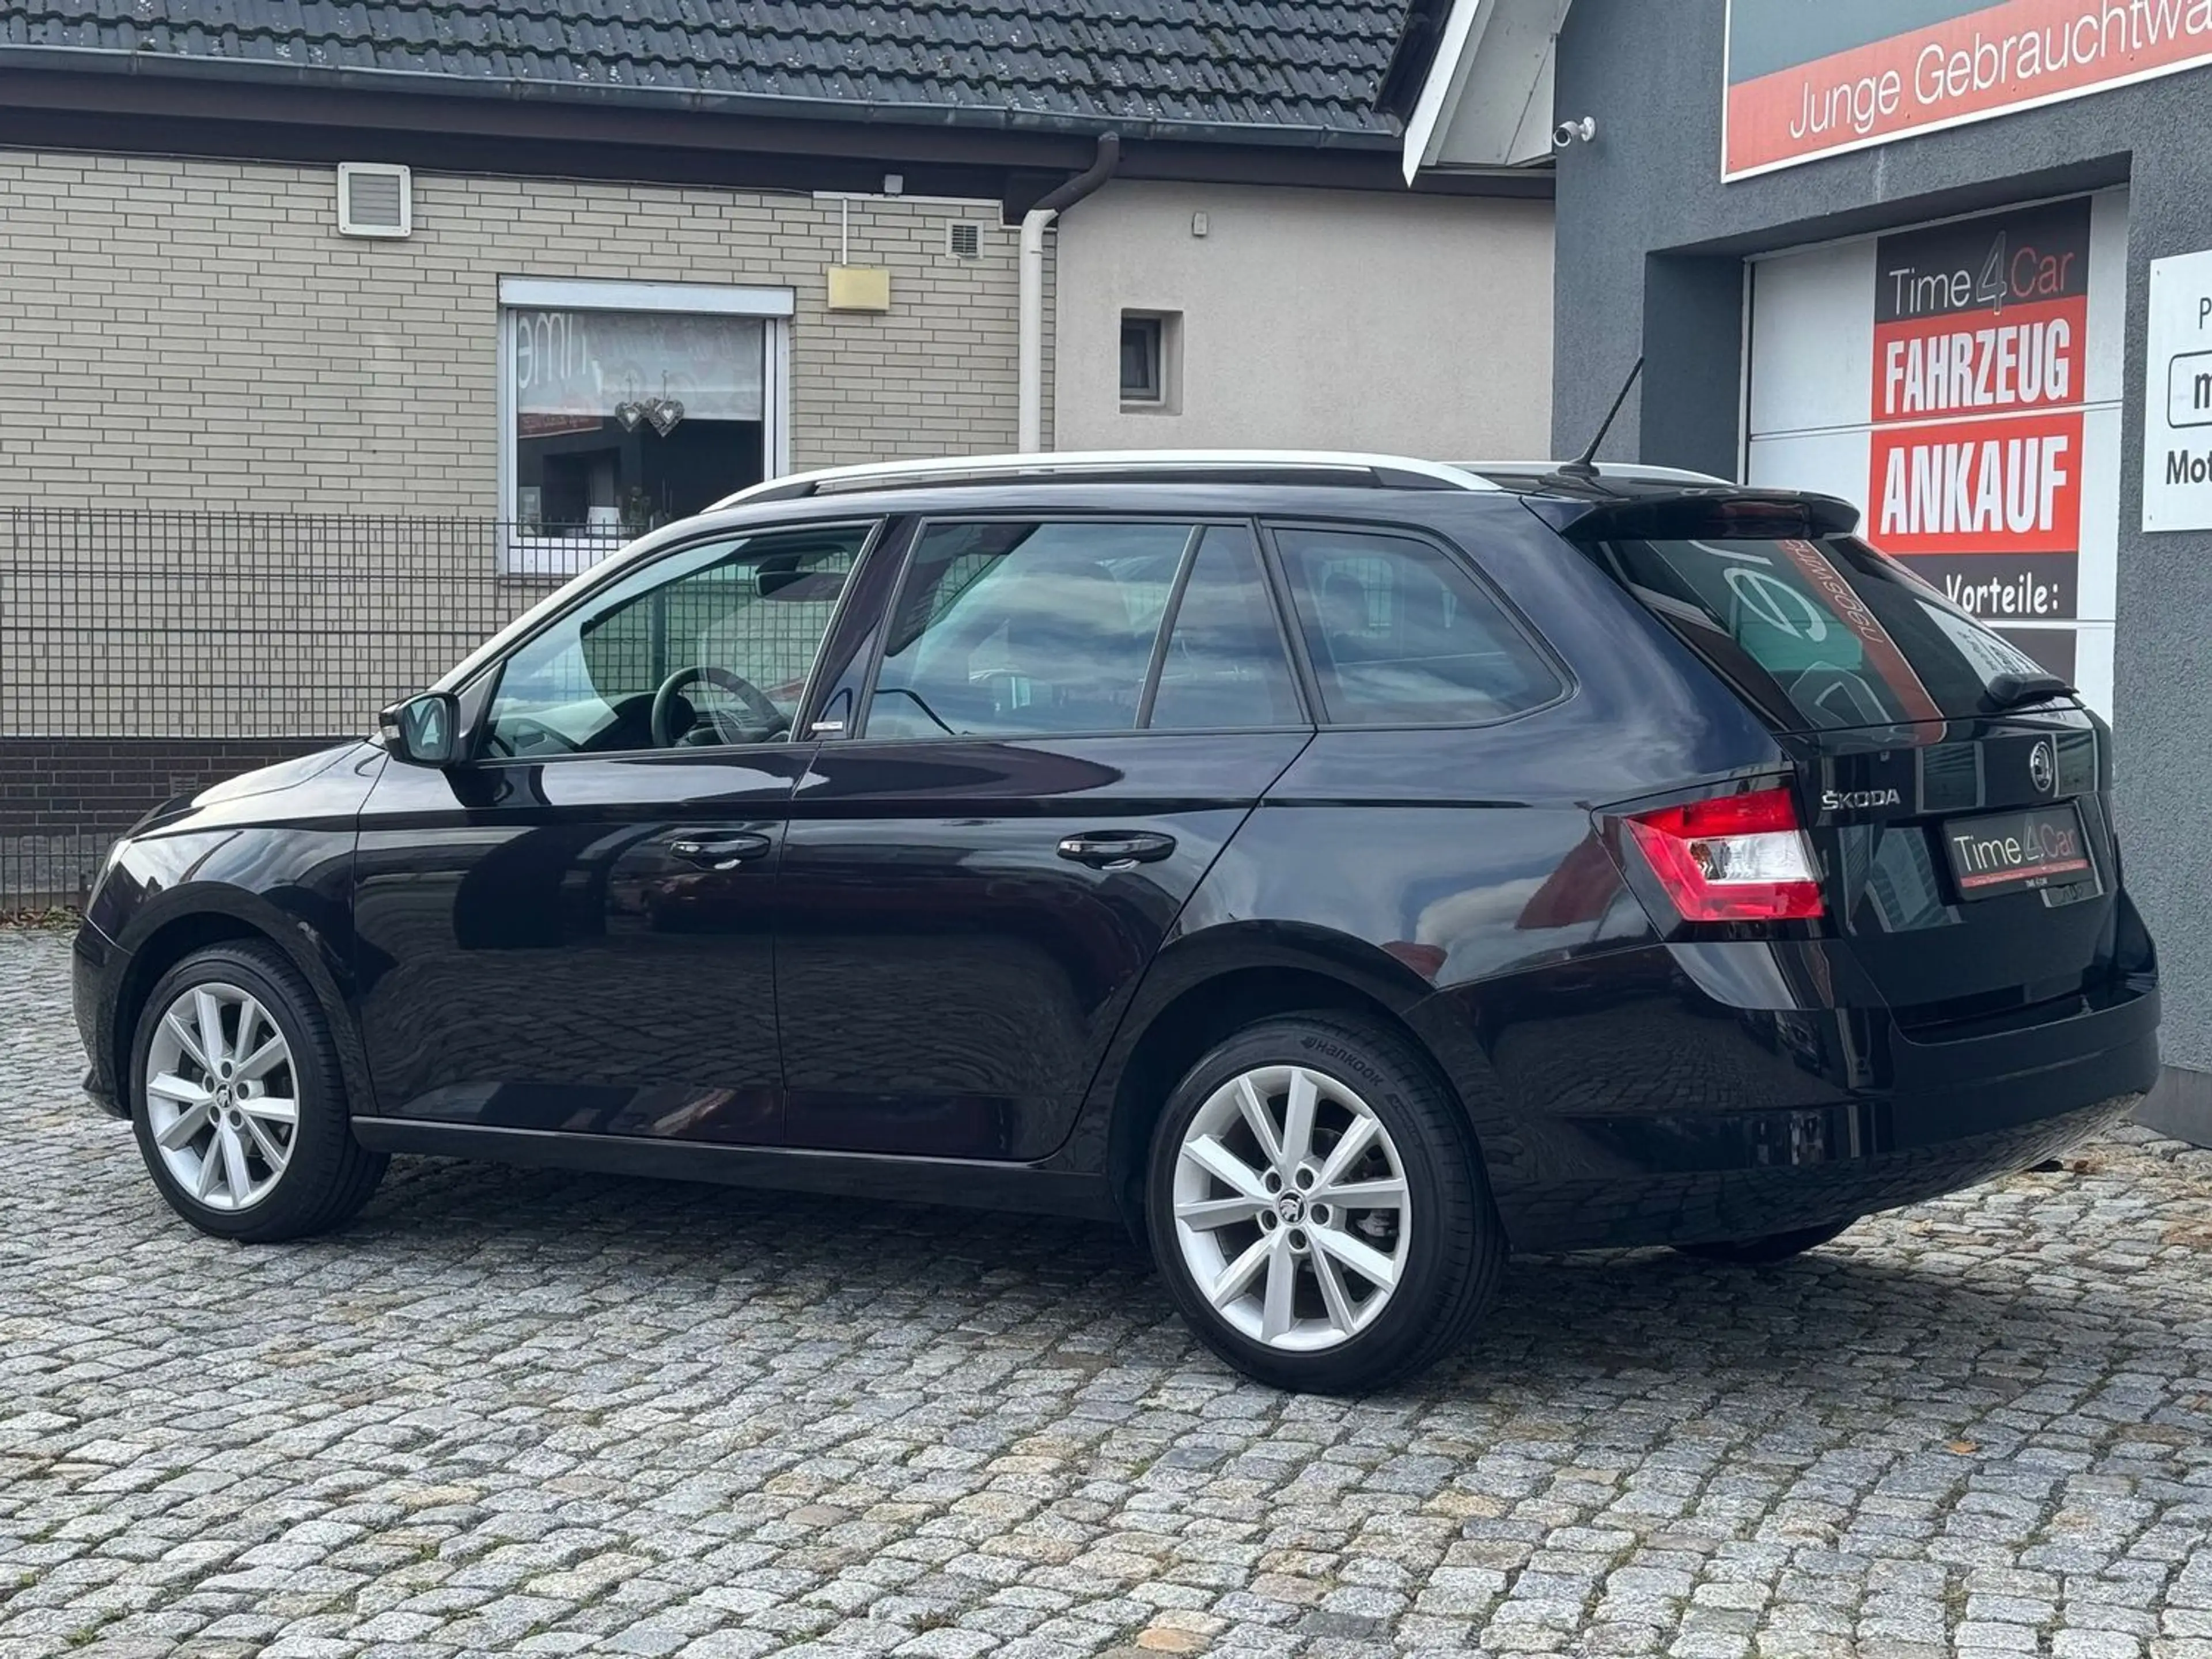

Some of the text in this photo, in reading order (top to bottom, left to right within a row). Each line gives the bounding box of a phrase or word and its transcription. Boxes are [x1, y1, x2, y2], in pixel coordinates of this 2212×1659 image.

[1789, 70, 1901, 139] Junge
[1884, 318, 2071, 414] FAHRZEUG
[1880, 435, 2069, 536] ANKAUF
[1946, 571, 2059, 615] Vorteile:
[1821, 789, 1901, 811] ŠKODA
